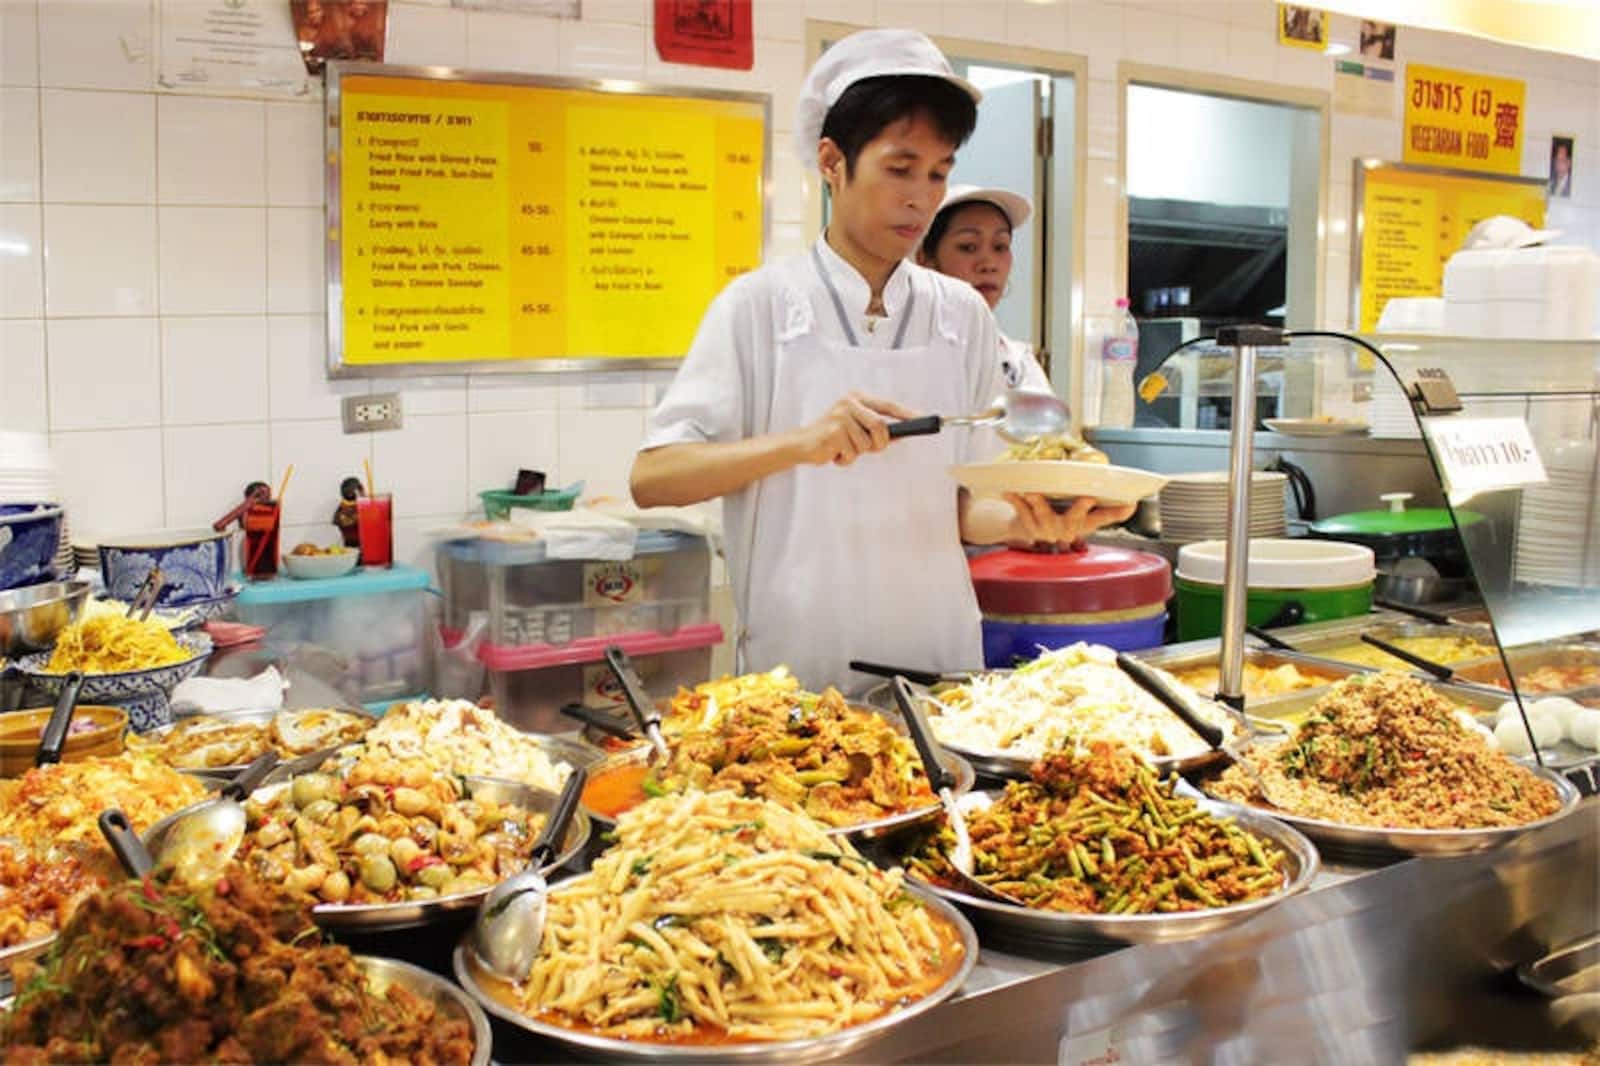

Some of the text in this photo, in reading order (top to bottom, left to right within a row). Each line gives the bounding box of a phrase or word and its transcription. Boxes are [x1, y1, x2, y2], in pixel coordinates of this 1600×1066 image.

[1412, 79, 1465, 114] อาหาร
[1411, 125, 1489, 160] VEGETARIAN FOOD
